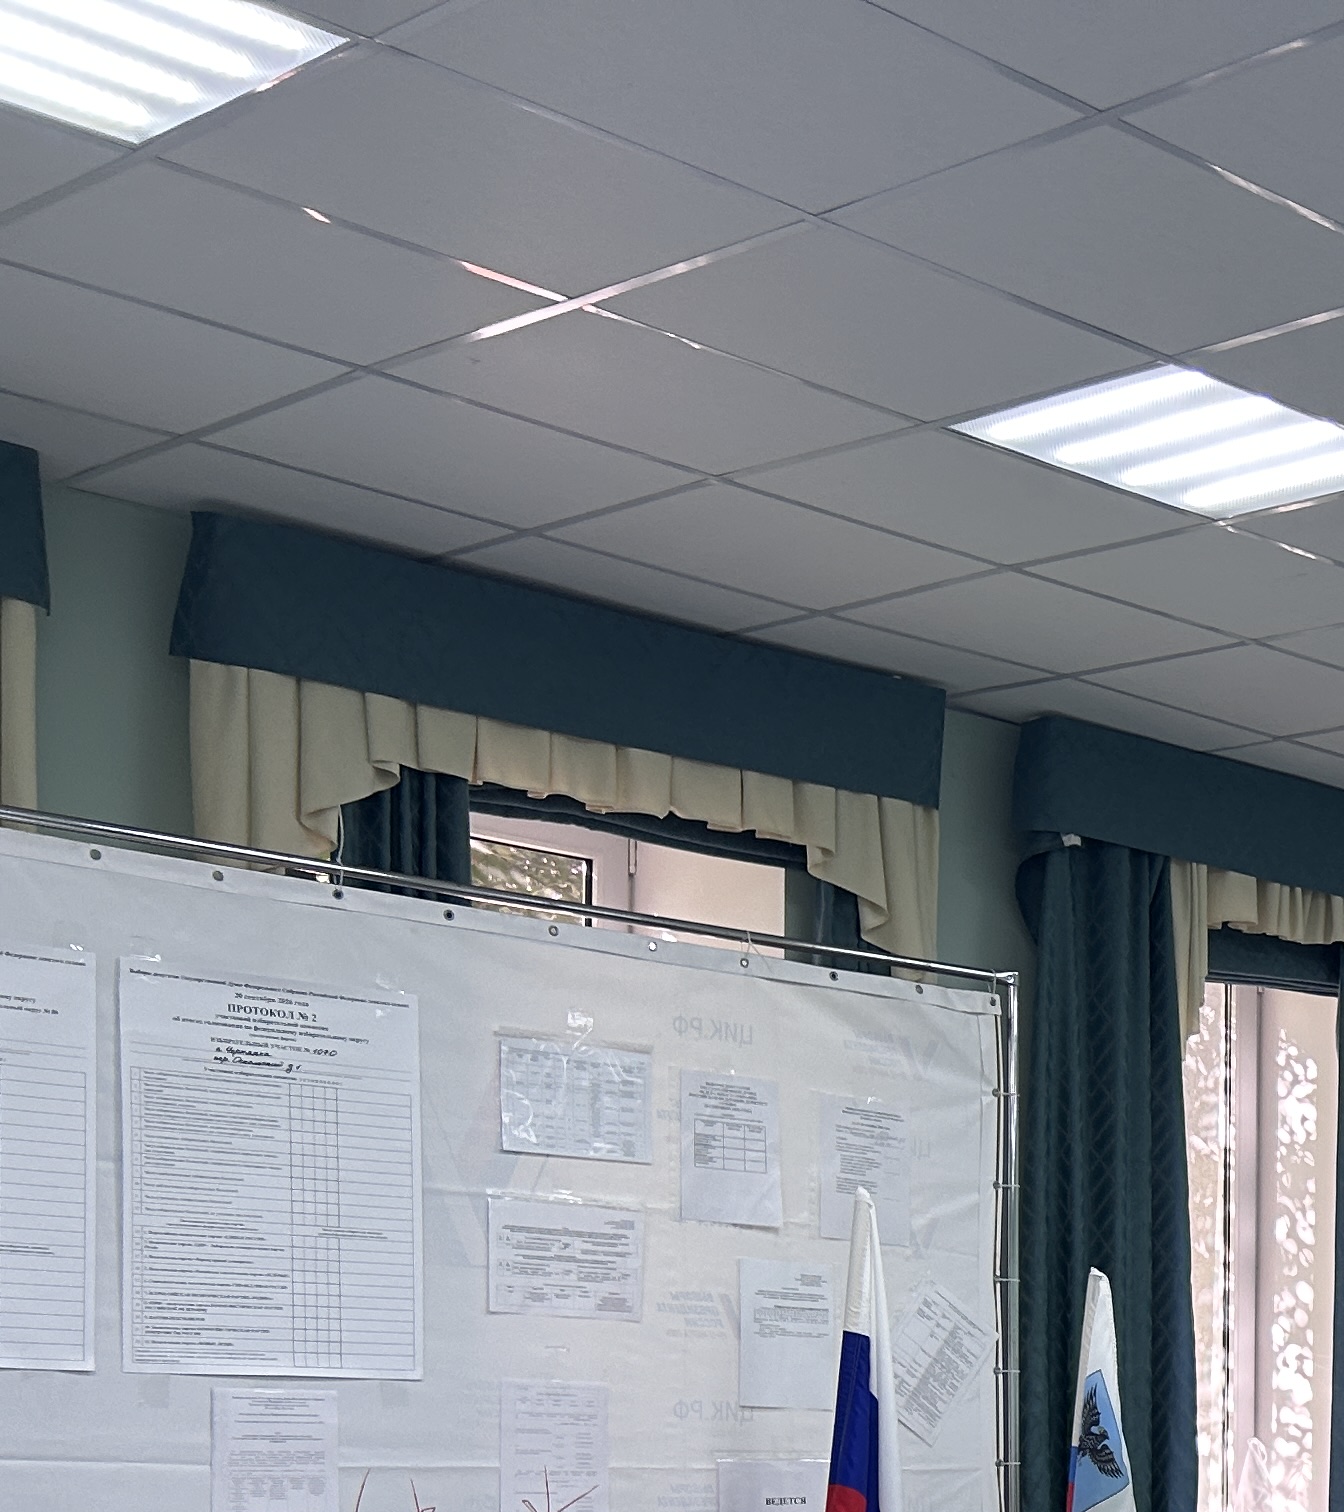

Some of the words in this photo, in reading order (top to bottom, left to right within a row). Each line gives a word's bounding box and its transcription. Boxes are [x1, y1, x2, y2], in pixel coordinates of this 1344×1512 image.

[227, 1003, 295, 1020] ПРОТОКОЛ
[312, 1014, 317, 1022] 2
[765, 1496, 807, 1506] ВЕДЕТСЯ
